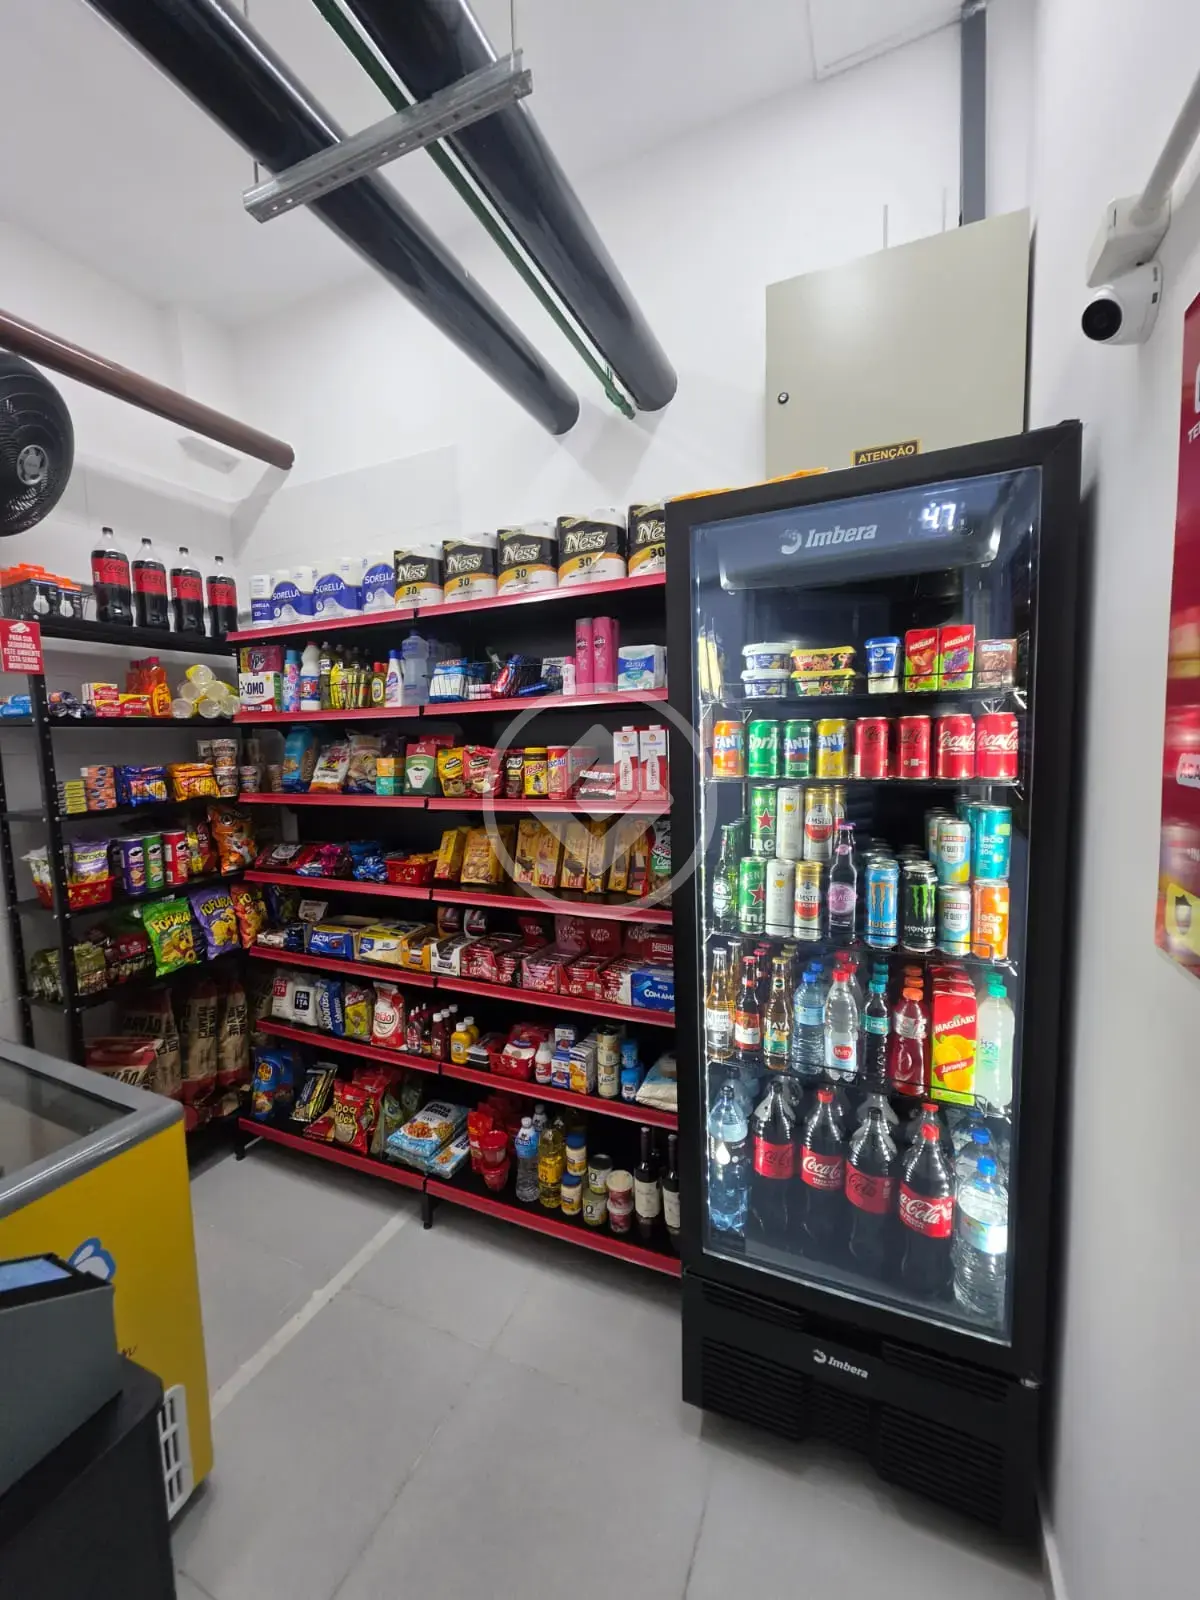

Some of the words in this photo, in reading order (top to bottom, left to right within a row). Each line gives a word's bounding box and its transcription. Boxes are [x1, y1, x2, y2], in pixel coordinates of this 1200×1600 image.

[858, 444, 915, 464] ATENÇÃO
[921, 503, 956, 531] 47
[565, 531, 608, 553] Ness
[805, 524, 878, 548] Imbera
[502, 543, 541, 565] Ness
[578, 557, 592, 568] 30
[397, 563, 429, 581] Ness
[446, 554, 482, 574] Ness
[515, 568, 527, 579] 30
[364, 571, 395, 585] SORELLA
[457, 577, 470, 587] 30
[272, 589, 300, 601] SORELLA
[315, 582, 345, 594] SORELLA
[405, 586, 418, 595] 30
[247, 682, 264, 694] OMO
[200, 896, 234, 916] FOFURA
[935, 1014, 976, 1034] MAGUARY
[828, 1356, 869, 1379] Imbera
